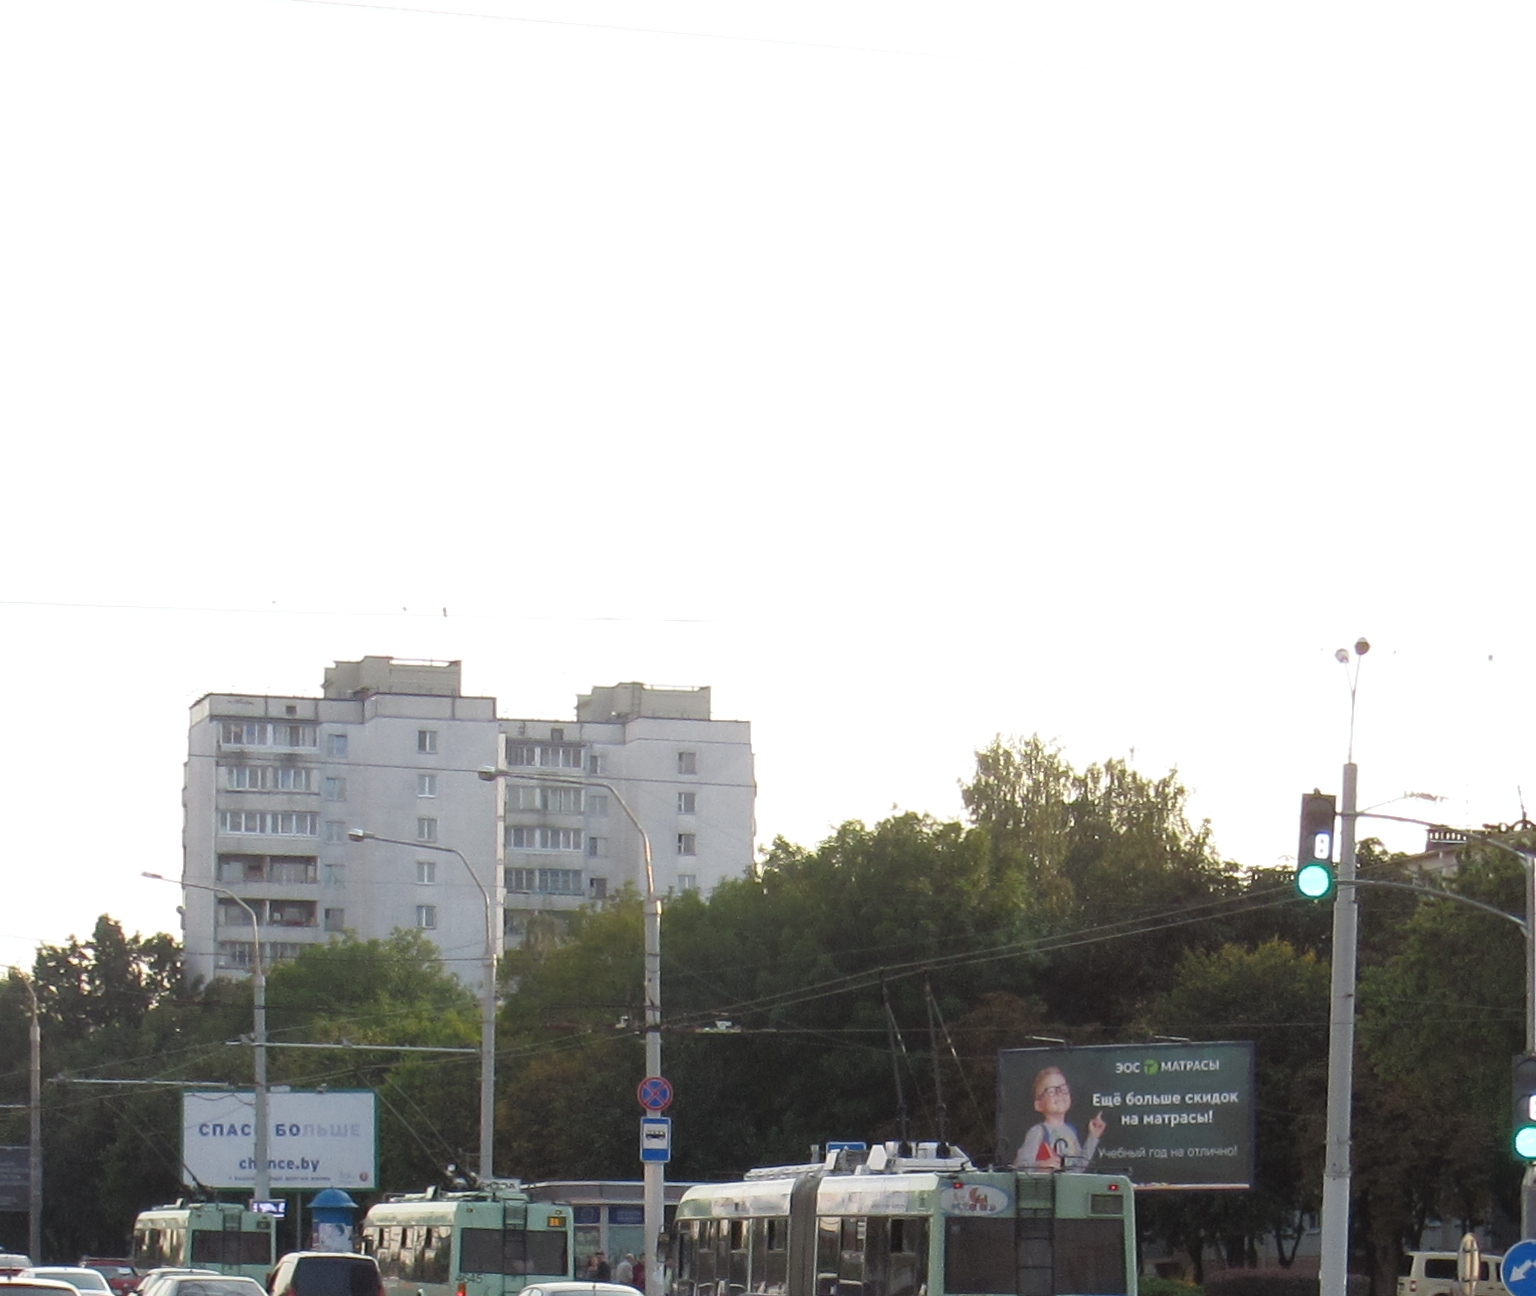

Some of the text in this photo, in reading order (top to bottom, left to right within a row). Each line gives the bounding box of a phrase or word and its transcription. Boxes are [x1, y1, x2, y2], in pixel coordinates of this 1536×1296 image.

[1115, 1060, 1220, 1074] ЭОС МАТРАСЫ
[1092, 1091, 1239, 1107] Ещё больше скидок
[1121, 1110, 1213, 1127] на матрасы!
[198, 1123, 362, 1137] СПАС БОЛЬШЕ
[1098, 1146, 1238, 1160] Учебный год на отлично!
[239, 1156, 320, 1172] chnce.by
